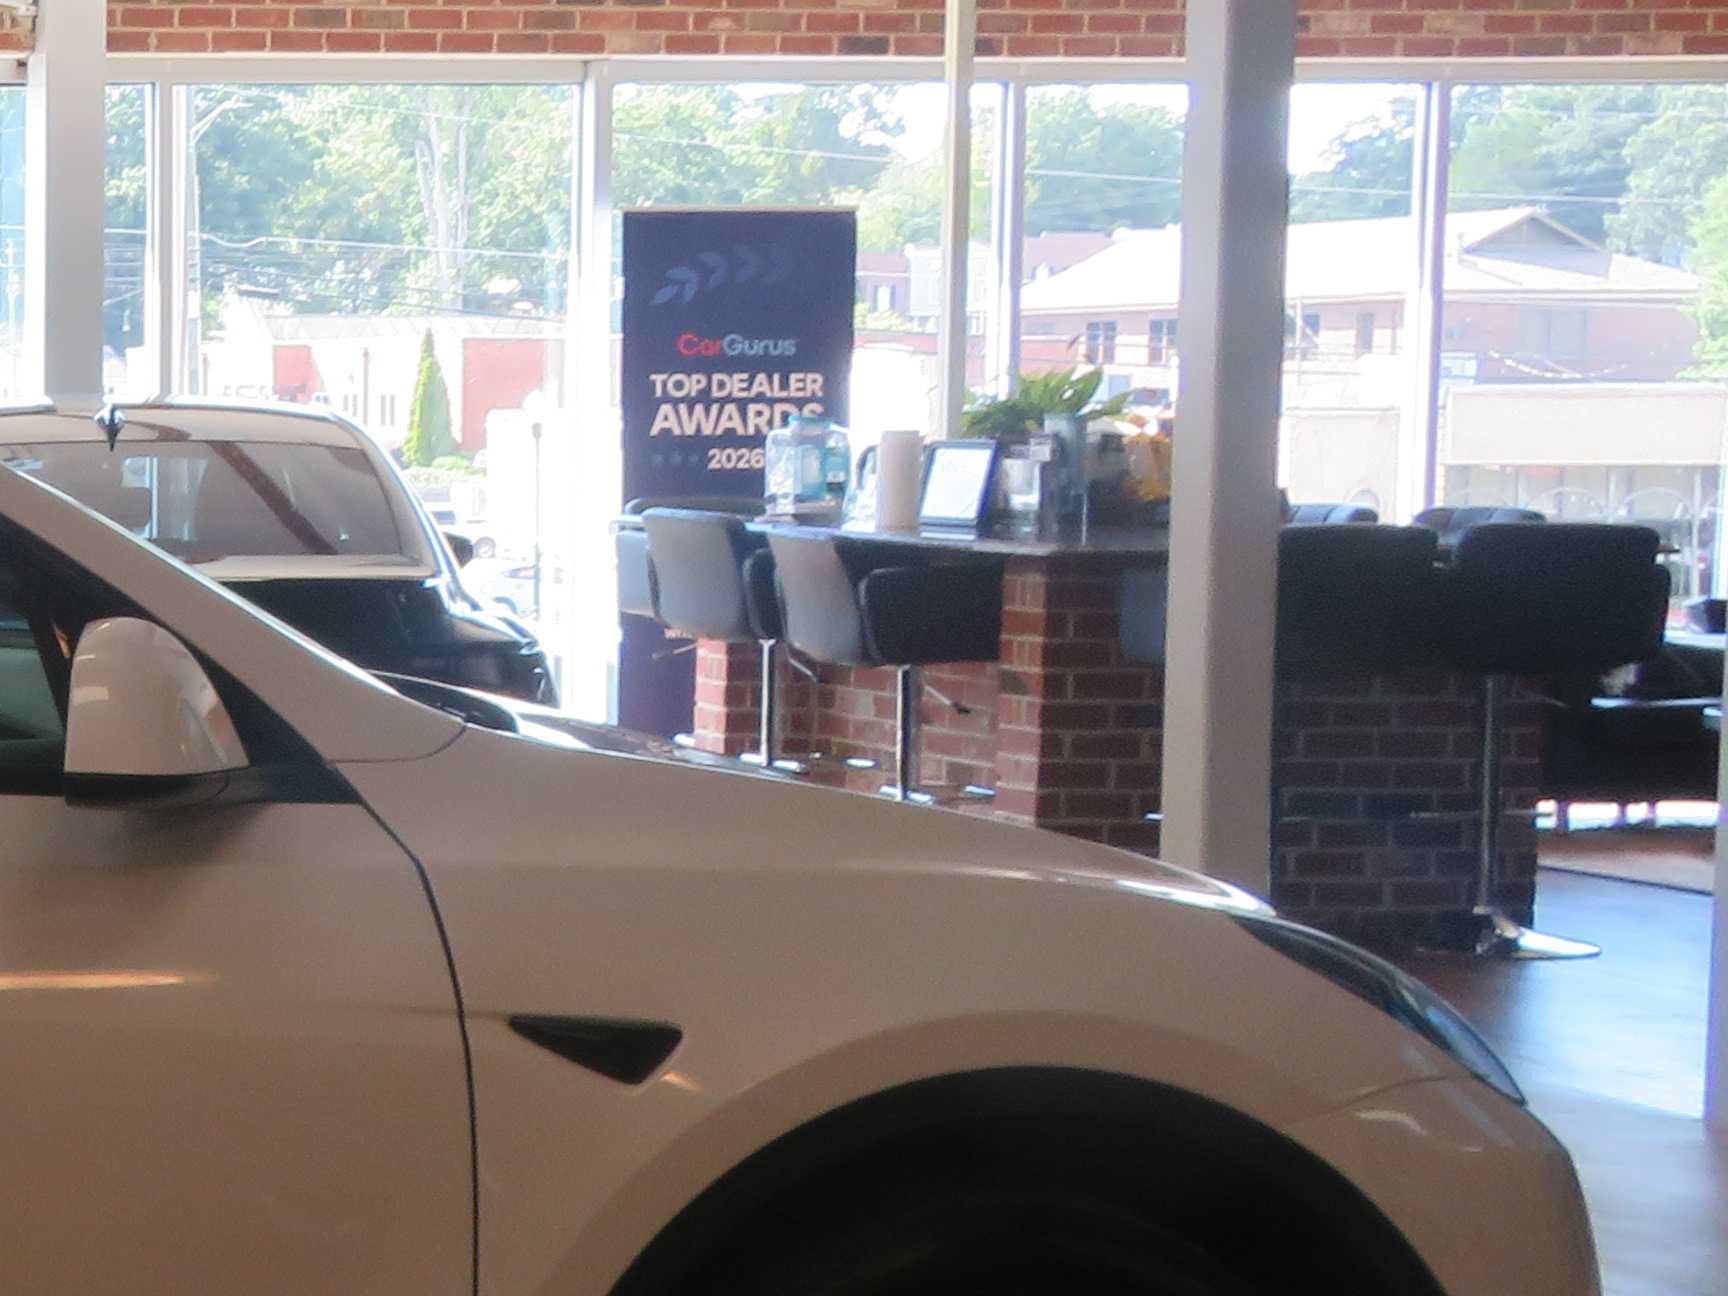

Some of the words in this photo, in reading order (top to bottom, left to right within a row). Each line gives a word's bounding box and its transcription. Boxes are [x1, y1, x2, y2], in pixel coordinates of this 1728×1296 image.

[677, 333, 797, 357] CarGurus
[649, 373, 707, 398] TOP
[711, 372, 825, 398] DEALER
